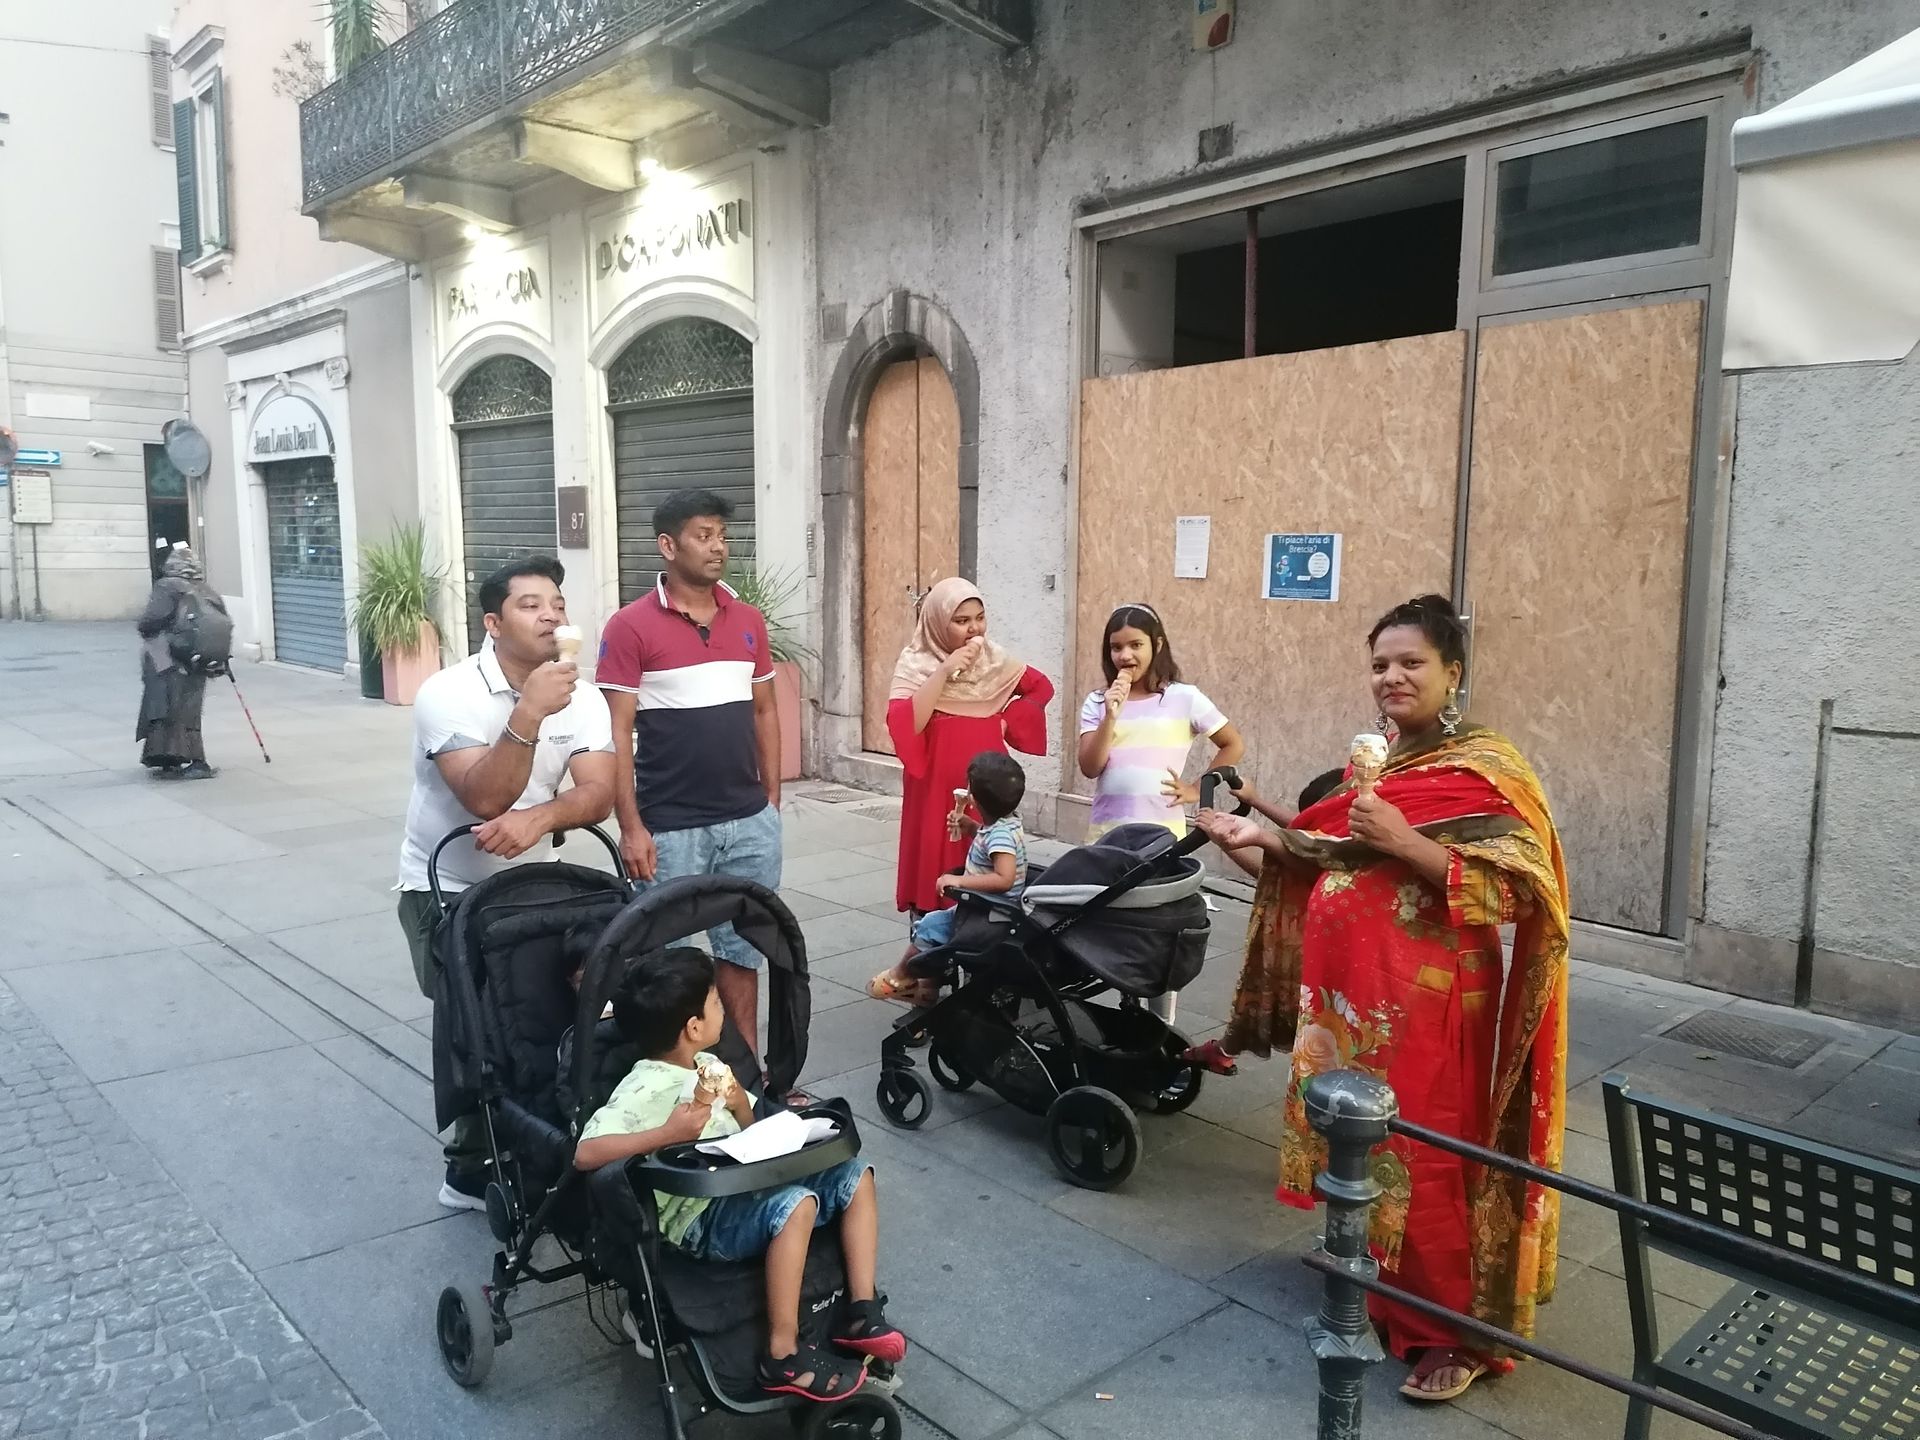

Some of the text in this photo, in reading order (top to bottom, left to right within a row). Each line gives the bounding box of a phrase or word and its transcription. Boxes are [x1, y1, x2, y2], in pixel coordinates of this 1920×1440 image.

[293, 422, 317, 450] David
[571, 512, 585, 530] 87
[1278, 536, 1285, 544] Ti
[1285, 536, 1304, 546] piace
[1322, 536, 1331, 544] di
[1289, 545, 1317, 553] Brescia?
